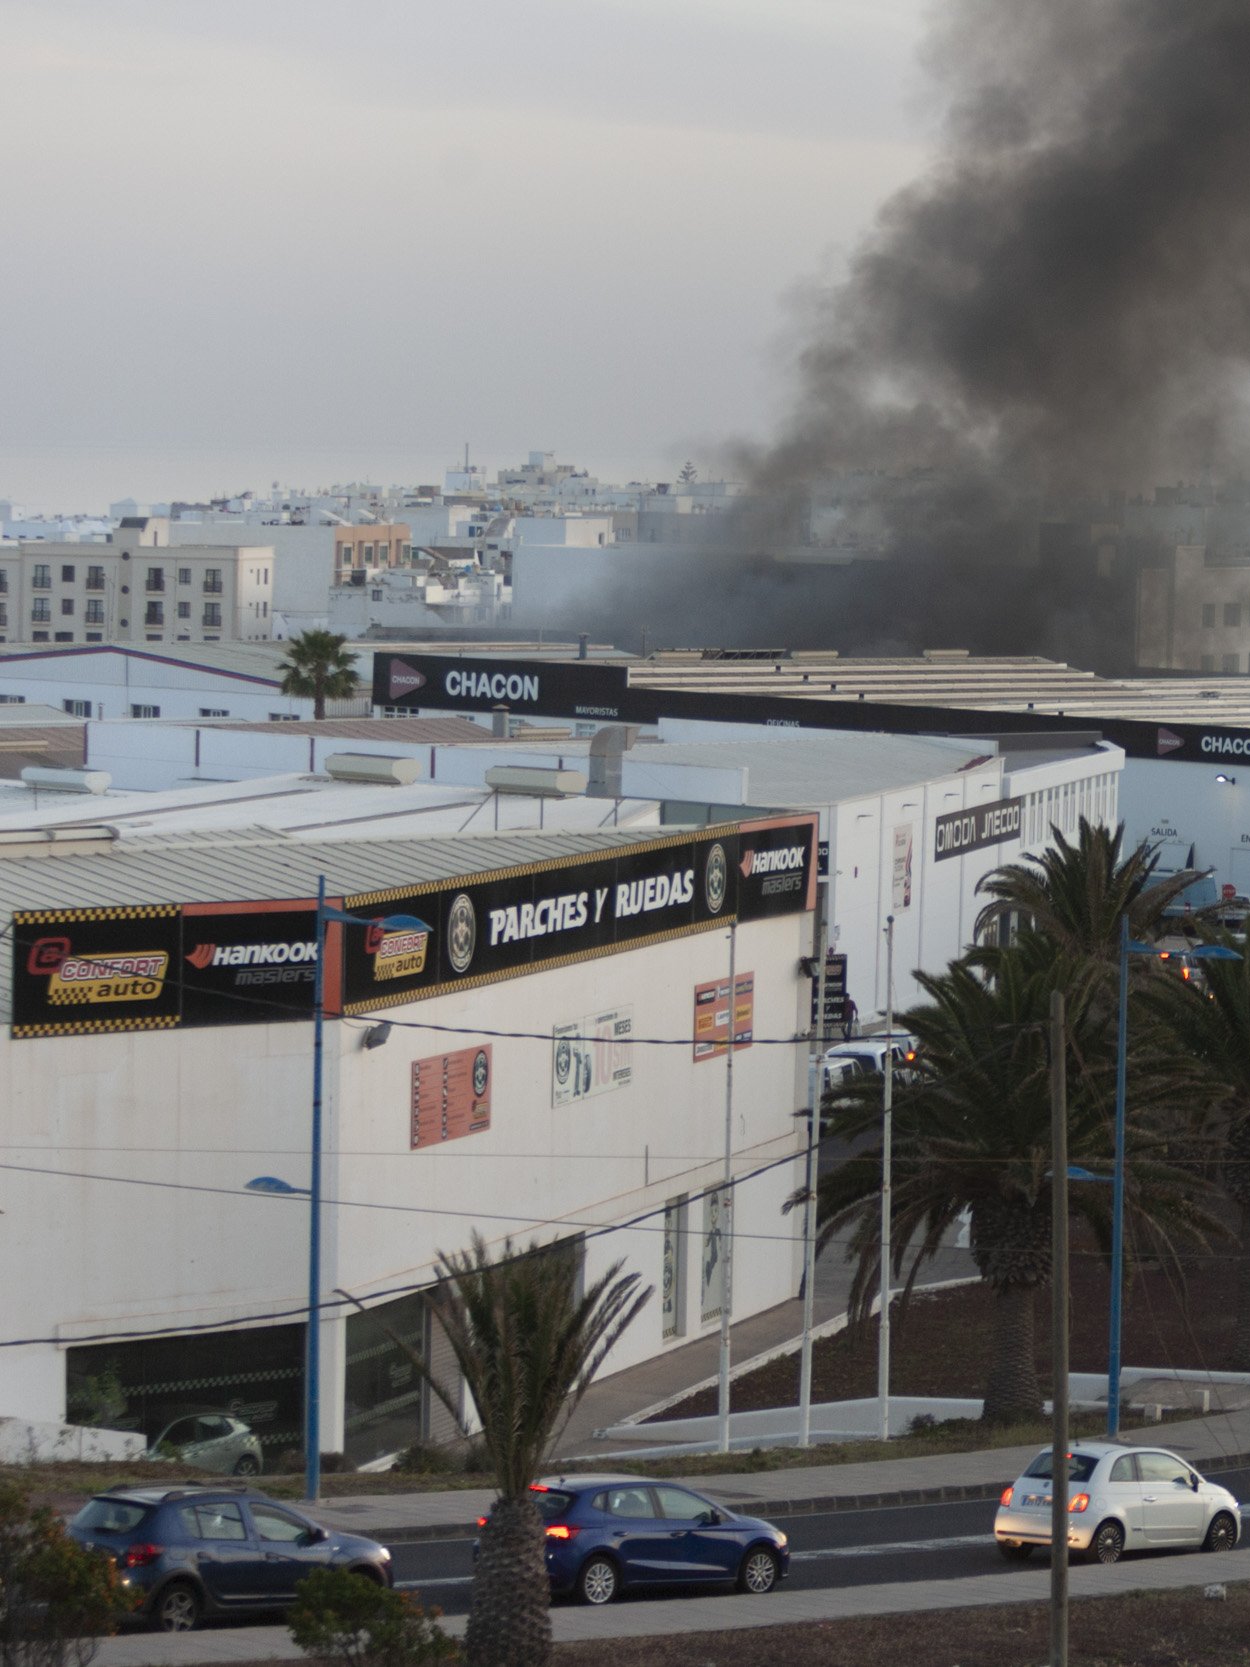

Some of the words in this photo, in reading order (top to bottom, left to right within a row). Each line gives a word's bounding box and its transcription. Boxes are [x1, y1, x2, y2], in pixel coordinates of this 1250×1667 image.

[392, 675, 420, 685] CHACON
[446, 671, 539, 701] CHACON
[575, 705, 618, 717] MAYORISTAS
[936, 816, 977, 853] OMODA
[981, 805, 1019, 839] JAECOO
[1151, 827, 1177, 837] SALIDA
[489, 892, 588, 946] PARCHES
[595, 888, 609, 923] Y
[615, 869, 695, 917] RUEDAS
[60, 957, 166, 981] CONFORT
[395, 953, 423, 972] auto
[96, 980, 157, 998] auto
